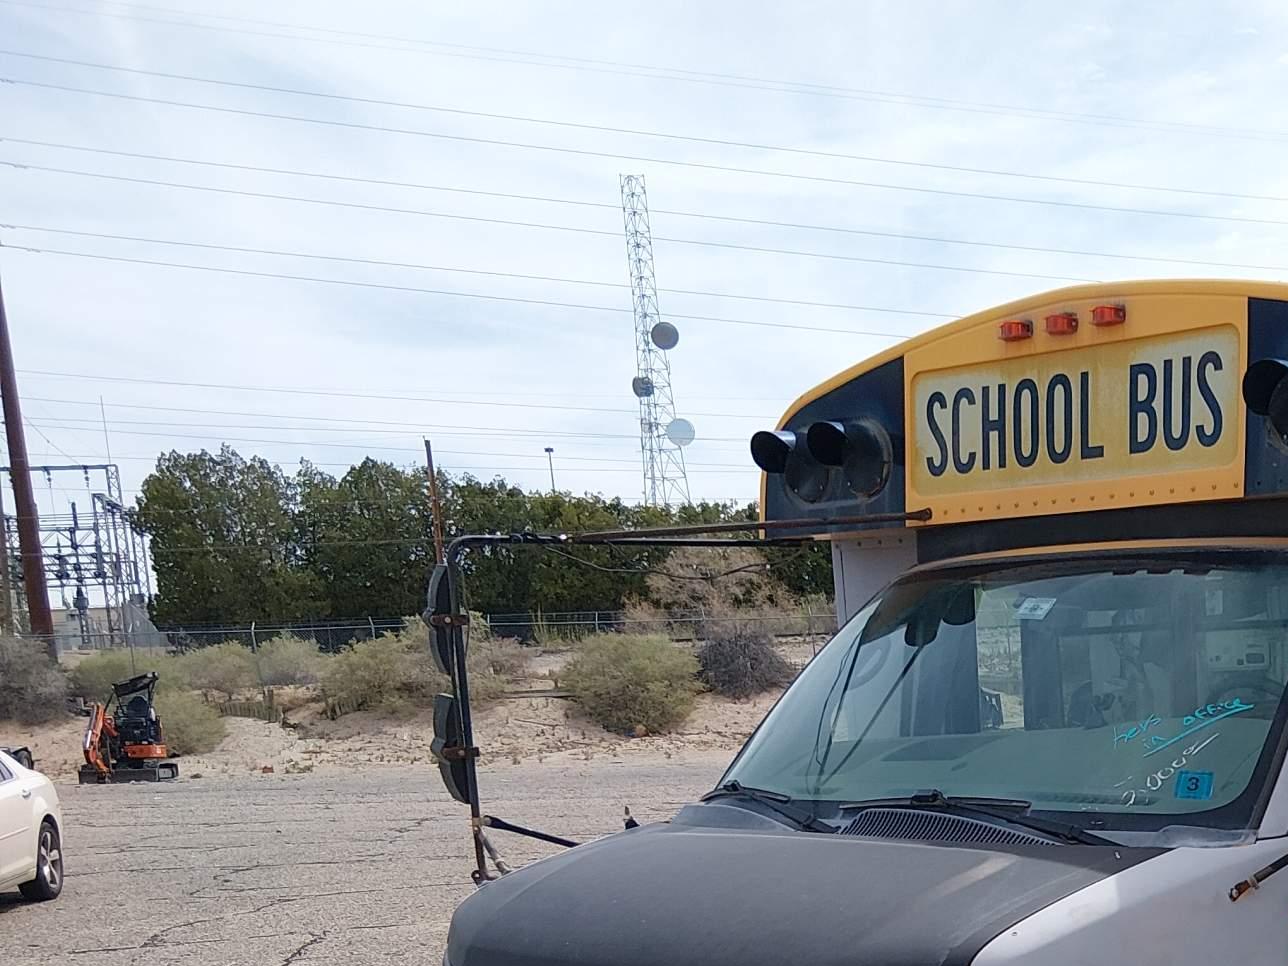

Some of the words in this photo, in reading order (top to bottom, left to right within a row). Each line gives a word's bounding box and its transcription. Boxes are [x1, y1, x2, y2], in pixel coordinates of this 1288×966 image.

[926, 371, 1104, 476] SCHOOL
[1129, 351, 1224, 454] BUS
[1186, 776, 1200, 791] 3
